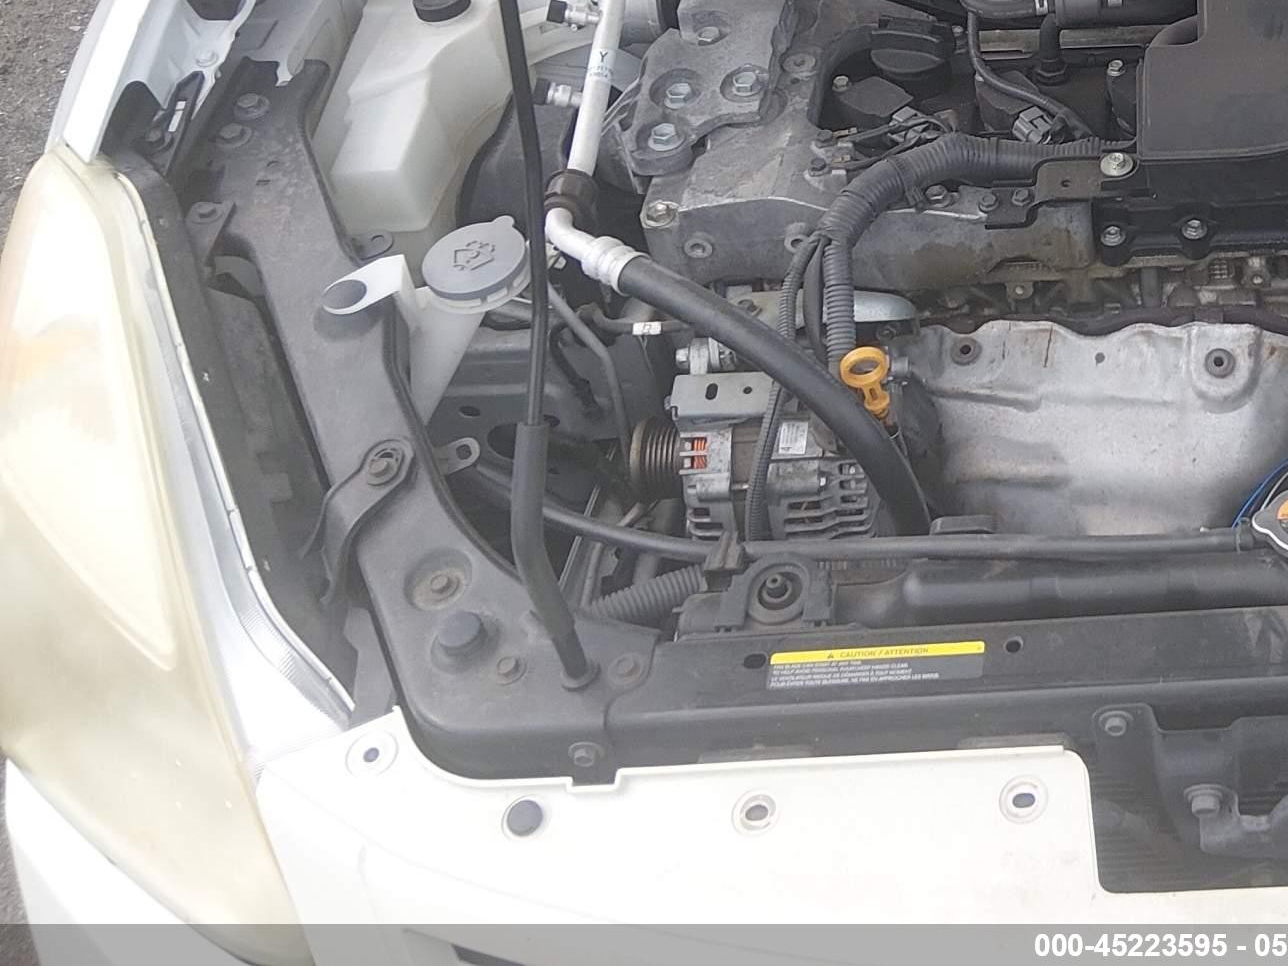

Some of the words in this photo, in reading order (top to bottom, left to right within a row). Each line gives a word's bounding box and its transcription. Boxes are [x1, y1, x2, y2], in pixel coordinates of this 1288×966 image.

[599, 50, 609, 63] Y
[840, 650, 876, 659] CAUTION
[883, 647, 929, 656] ATTENTION
